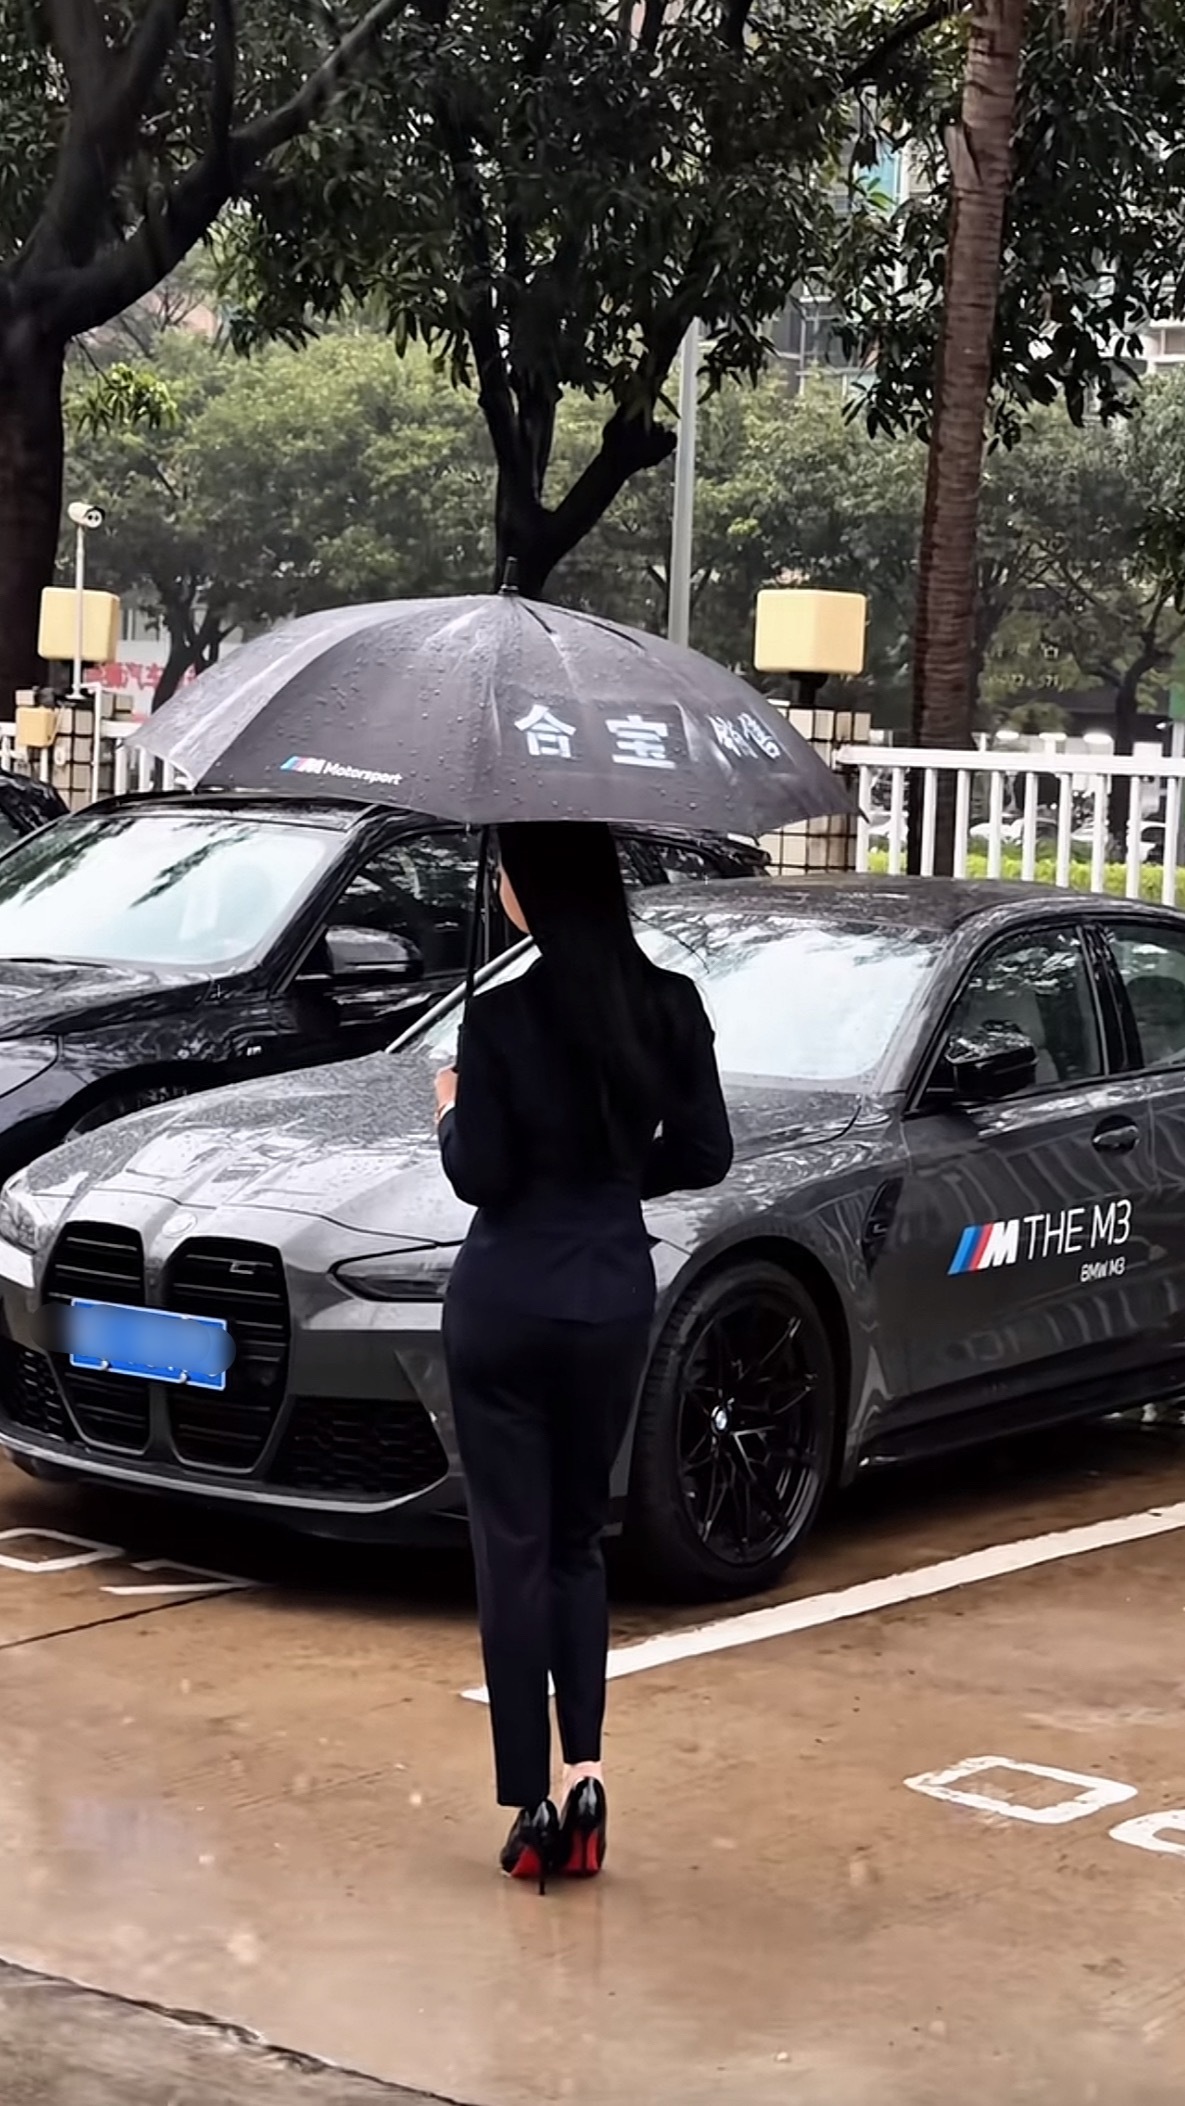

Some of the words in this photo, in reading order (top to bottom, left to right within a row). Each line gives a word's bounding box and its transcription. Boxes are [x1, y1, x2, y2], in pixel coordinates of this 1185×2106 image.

[323, 761, 403, 785] Motorsport
[1024, 1208, 1085, 1260] THE
[1091, 1199, 1132, 1248] M3
[1081, 1260, 1108, 1282] BMW
[1109, 1256, 1125, 1276] M3
